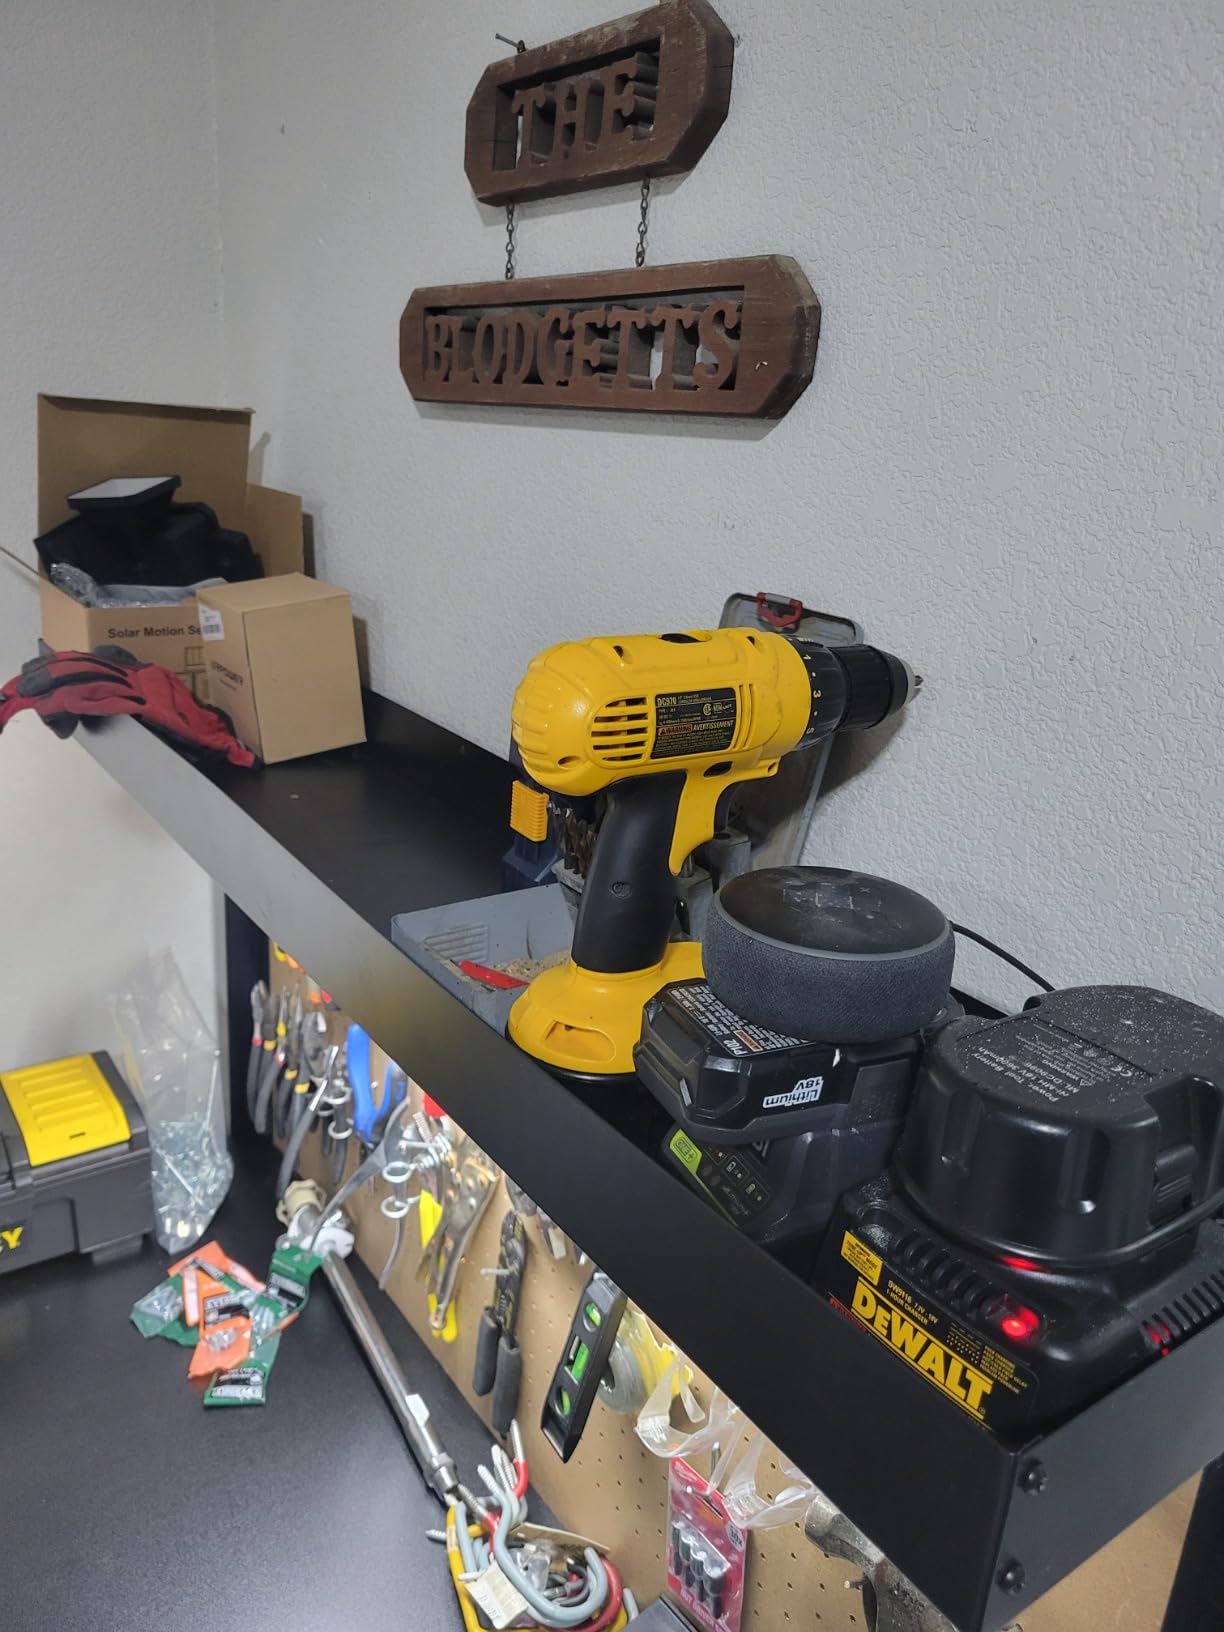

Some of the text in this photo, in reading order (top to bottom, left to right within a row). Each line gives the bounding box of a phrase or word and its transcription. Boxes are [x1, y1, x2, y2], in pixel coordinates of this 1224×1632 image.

[511, 52, 644, 165] THE
[425, 302, 742, 388] BLODGETTS
[107, 627, 140, 639] Solar
[144, 625, 184, 637] Motion
[656, 696, 676, 705] DC970
[813, 689, 821, 698] 3
[721, 1038, 749, 1055] P102
[969, 1051, 1061, 1102] Power Tool Battery
[1017, 1068, 1038, 1080] 18V
[796, 1078, 820, 1090] 18V
[765, 1089, 818, 1106] Lithium
[902, 1302, 929, 1325] CHARGER
[852, 1281, 993, 1411] DEWALT
